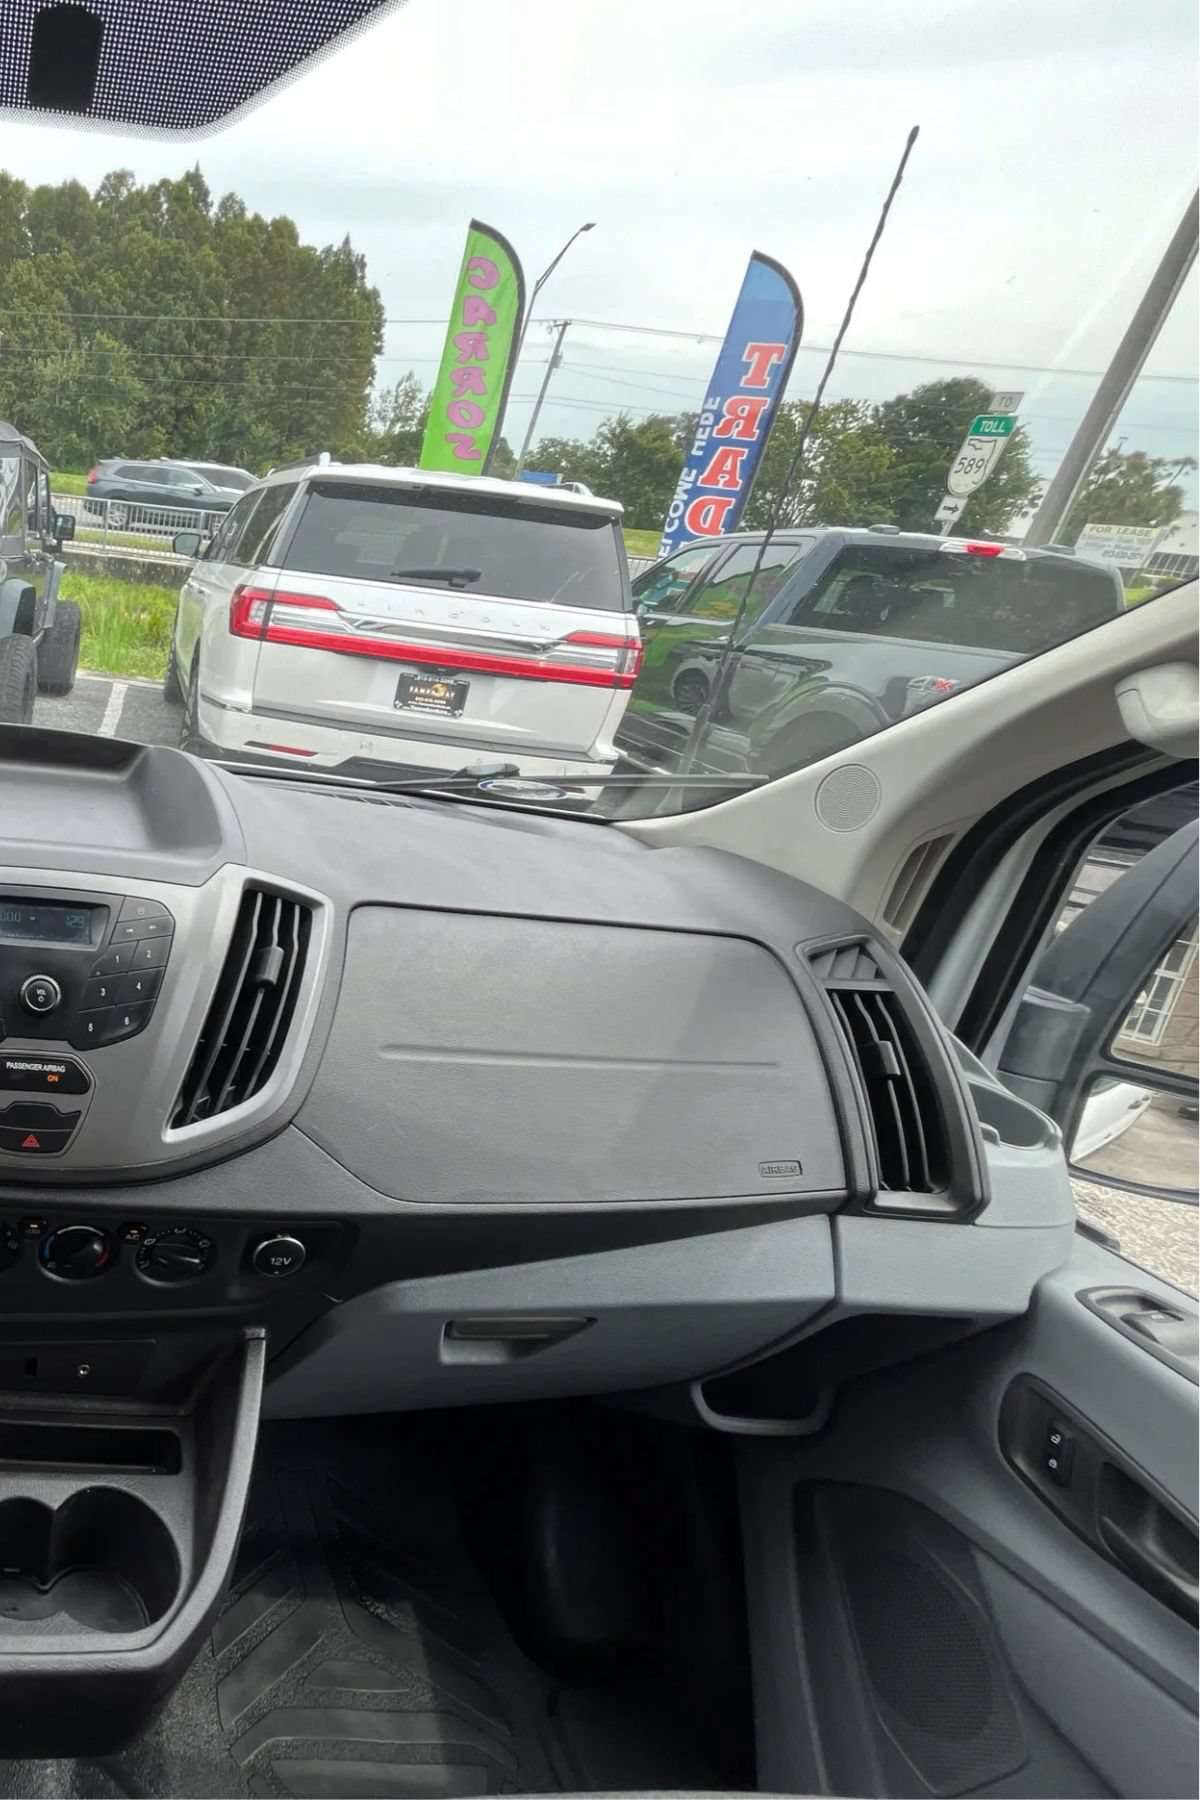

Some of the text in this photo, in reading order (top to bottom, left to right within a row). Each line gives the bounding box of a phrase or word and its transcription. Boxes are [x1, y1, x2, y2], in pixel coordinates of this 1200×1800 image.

[980, 420, 1006, 433] TOLL
[954, 457, 985, 474] 589
[1116, 527, 1152, 538] LEASE
[6, 1061, 66, 1073] PASSENGER AIRBAG
[47, 1074, 59, 1082] ON
[270, 1257, 291, 1265] 12V
